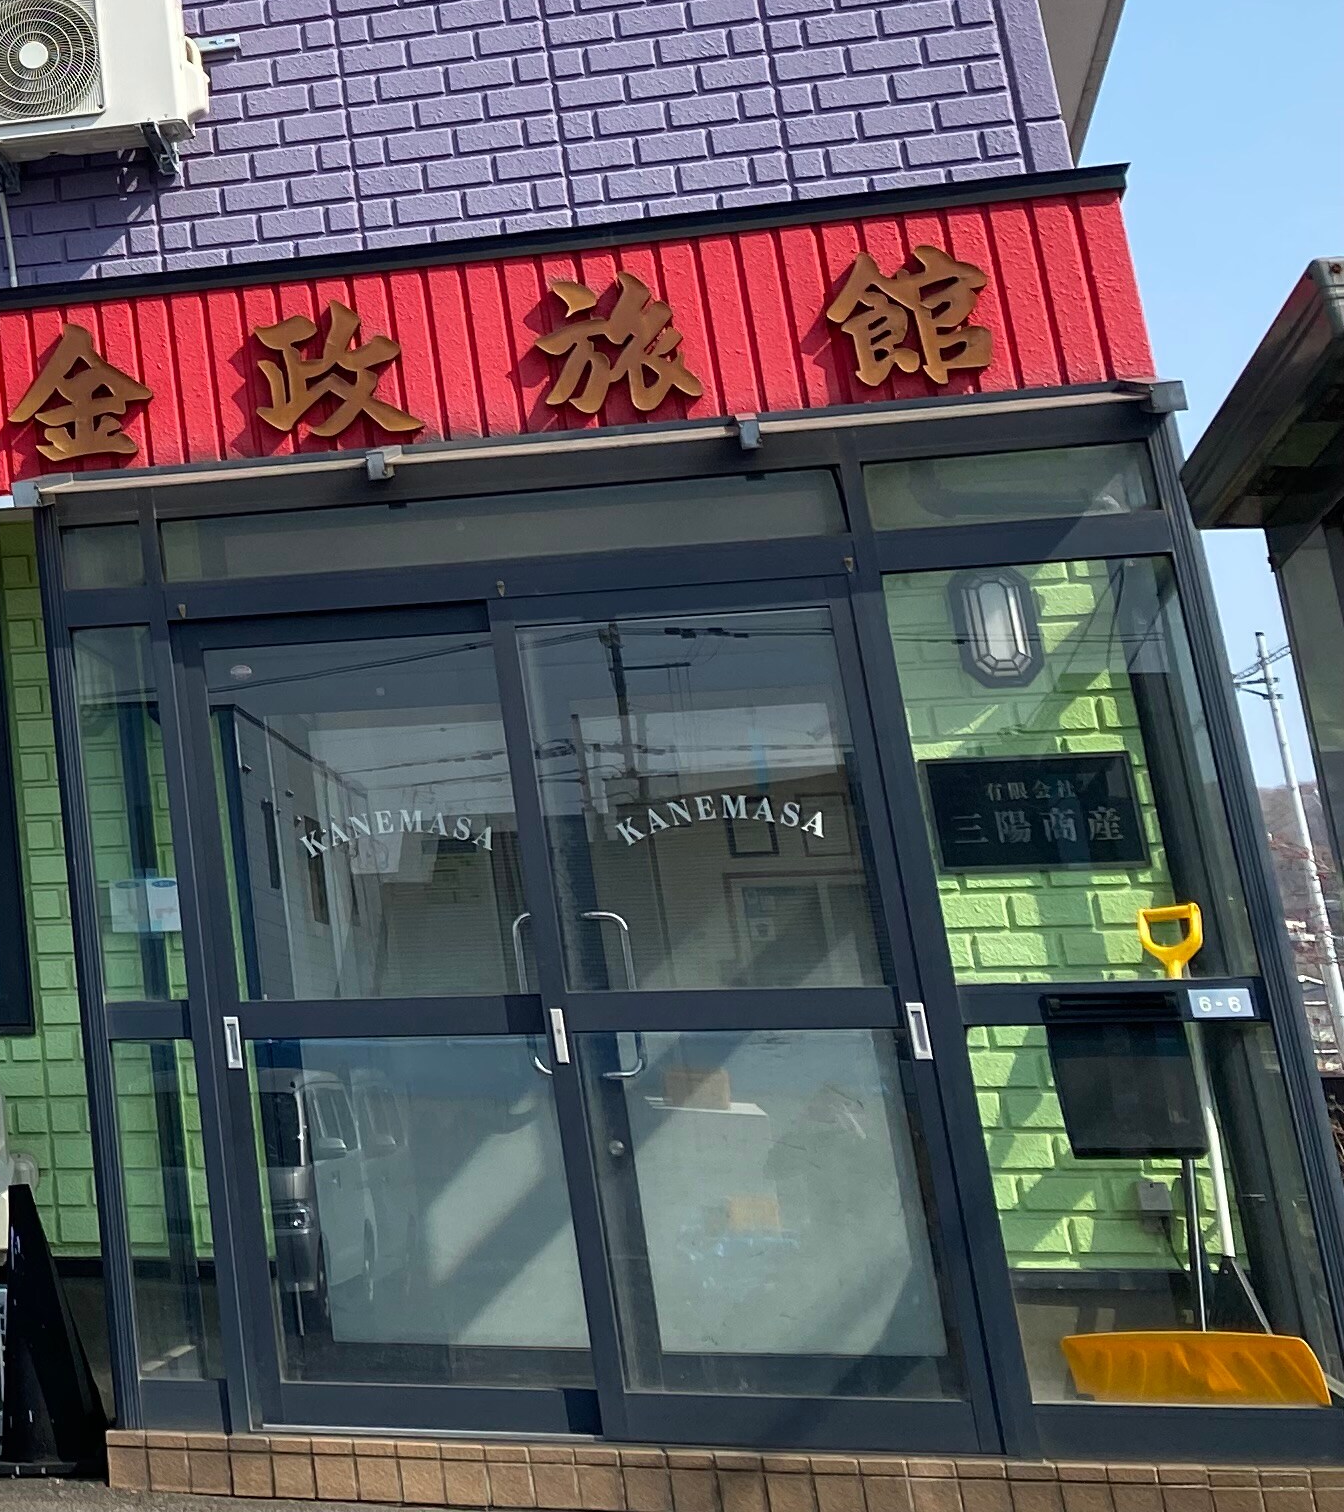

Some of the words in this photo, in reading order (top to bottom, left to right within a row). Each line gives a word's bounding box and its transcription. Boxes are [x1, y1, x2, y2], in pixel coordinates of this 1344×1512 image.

[8, 245, 992, 462] 金政旅館
[298, 809, 496, 859] KANEMASA
[615, 794, 827, 848] KANEMASA
[951, 805, 1125, 844] 三陽商産
